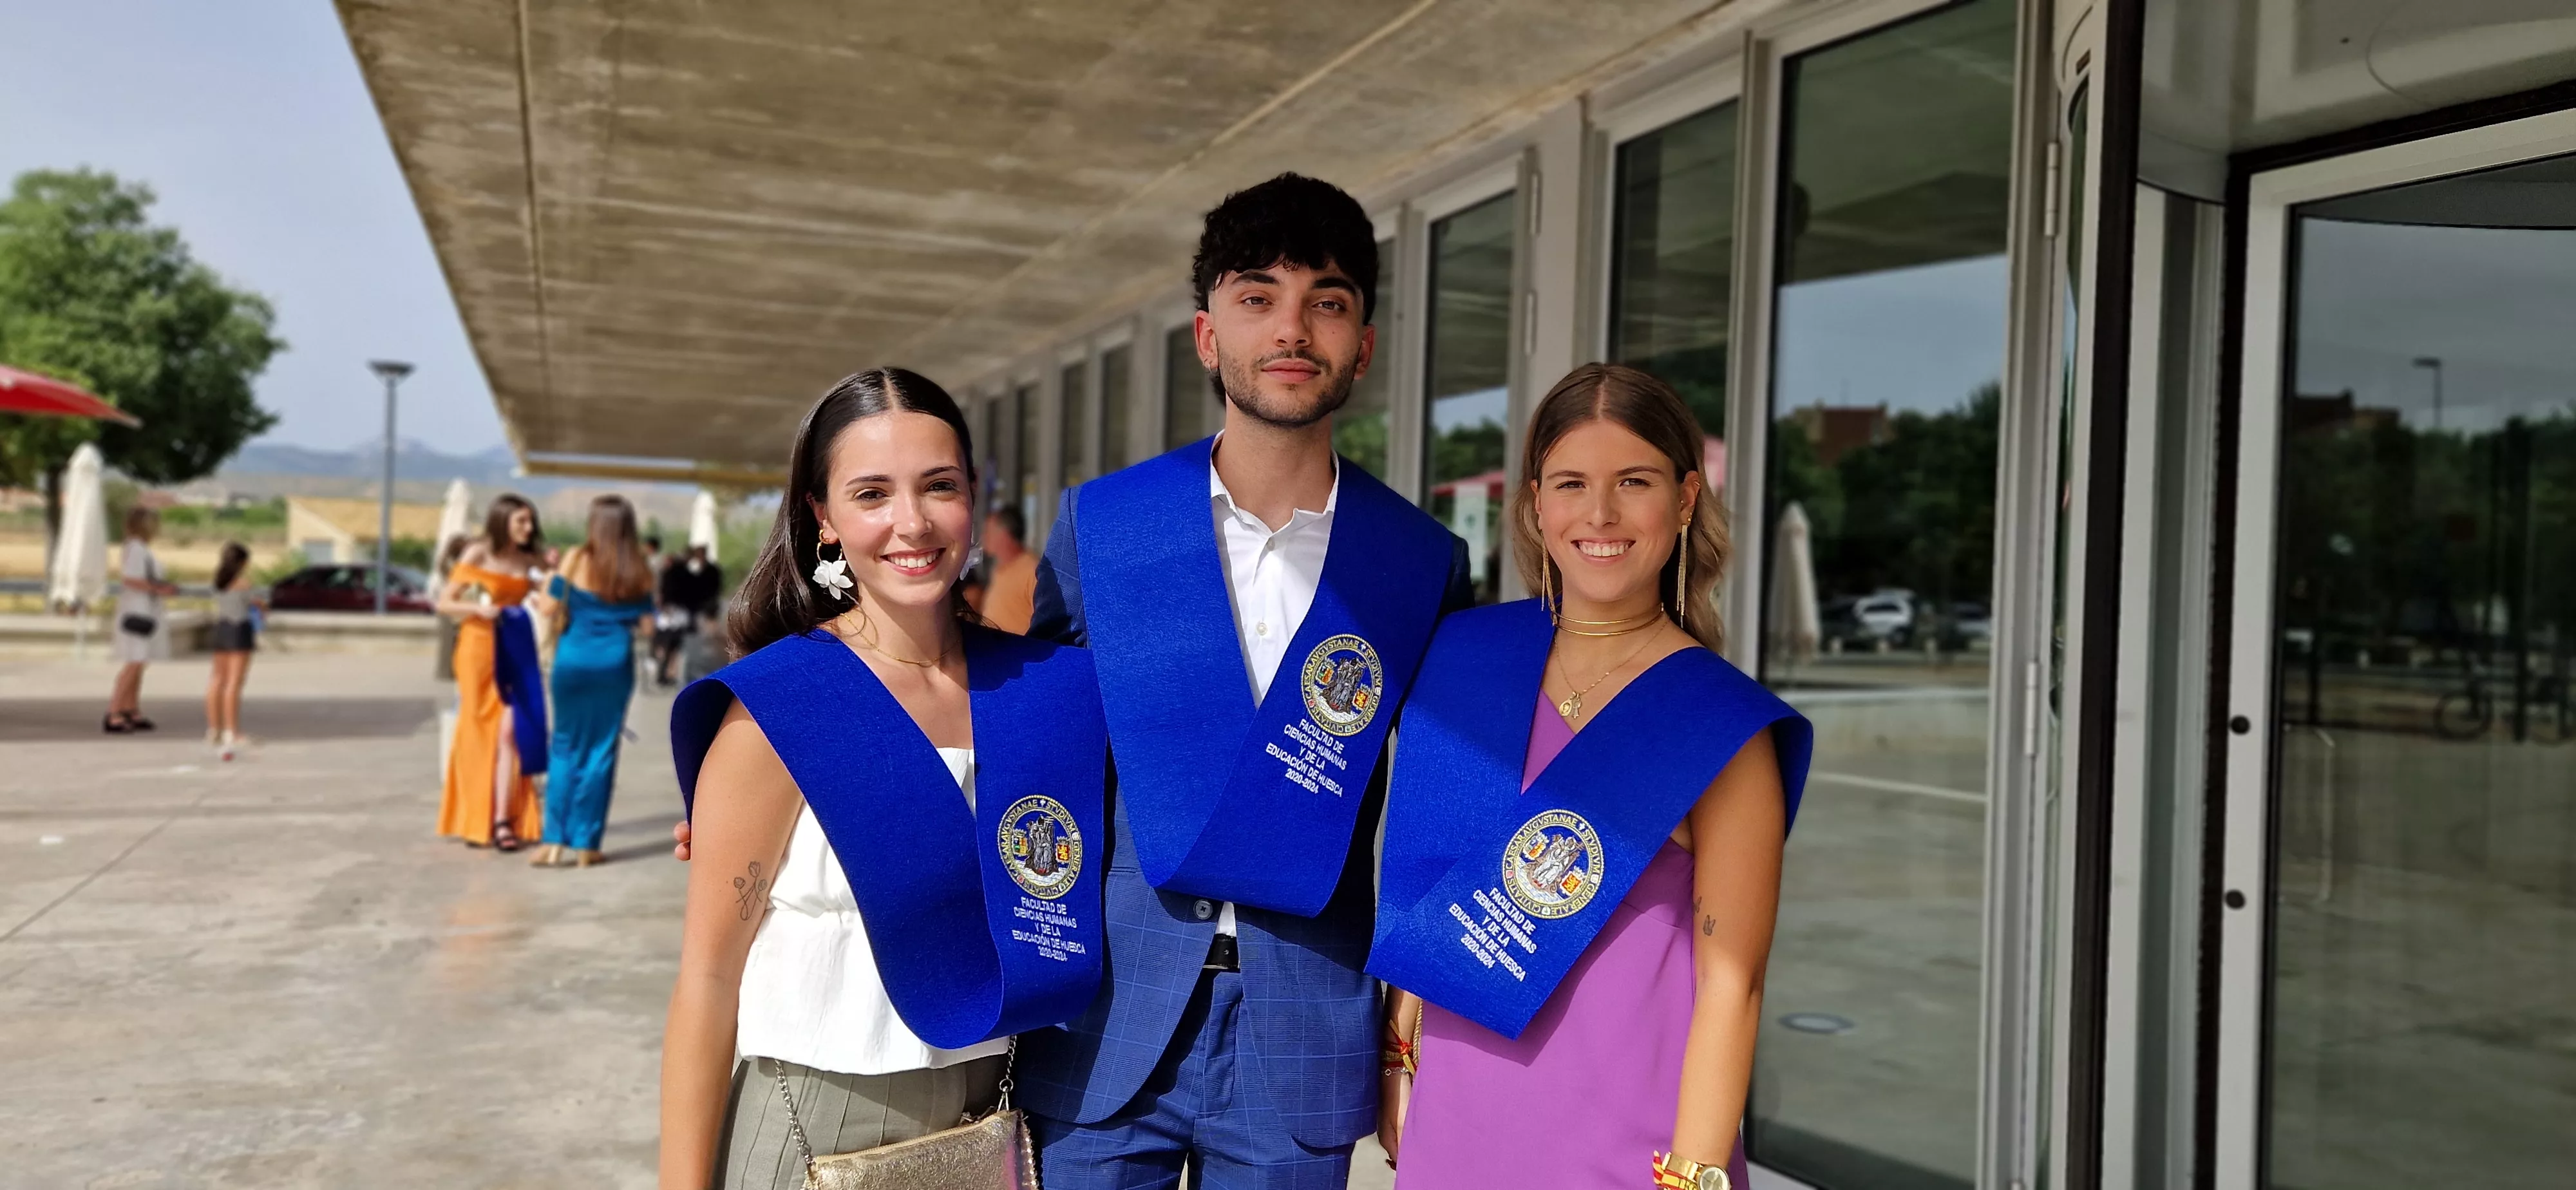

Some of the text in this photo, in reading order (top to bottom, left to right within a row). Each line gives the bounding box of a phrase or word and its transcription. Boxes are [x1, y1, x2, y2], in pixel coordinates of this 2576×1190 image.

[1284, 724, 1347, 770] CIENCIAS HUMANAS
[1299, 719, 1344, 754] FACULTAD DE
[1265, 742, 1343, 797] EDUCACIÓN DE HUESCA
[1300, 746, 1325, 770] Y DE LA
[1285, 768, 1318, 794] 2020-2024
[1014, 907, 1077, 928] CIENCIAS HUMANAS
[1021, 896, 1066, 914] FACULTAD DE
[1473, 889, 1537, 954] CIENCIAS HUMANAS
[1489, 887, 1536, 935] FACULTAD DE
[1012, 930, 1086, 954] EDUCACIÓN DE HUESCA
[1034, 922, 1061, 936] Y DE LA
[1449, 903, 1526, 982] EDUCACIÓN DE HUESCA
[1482, 915, 1510, 947] Y DE LA
[1461, 934, 1495, 968] 2020-2024
